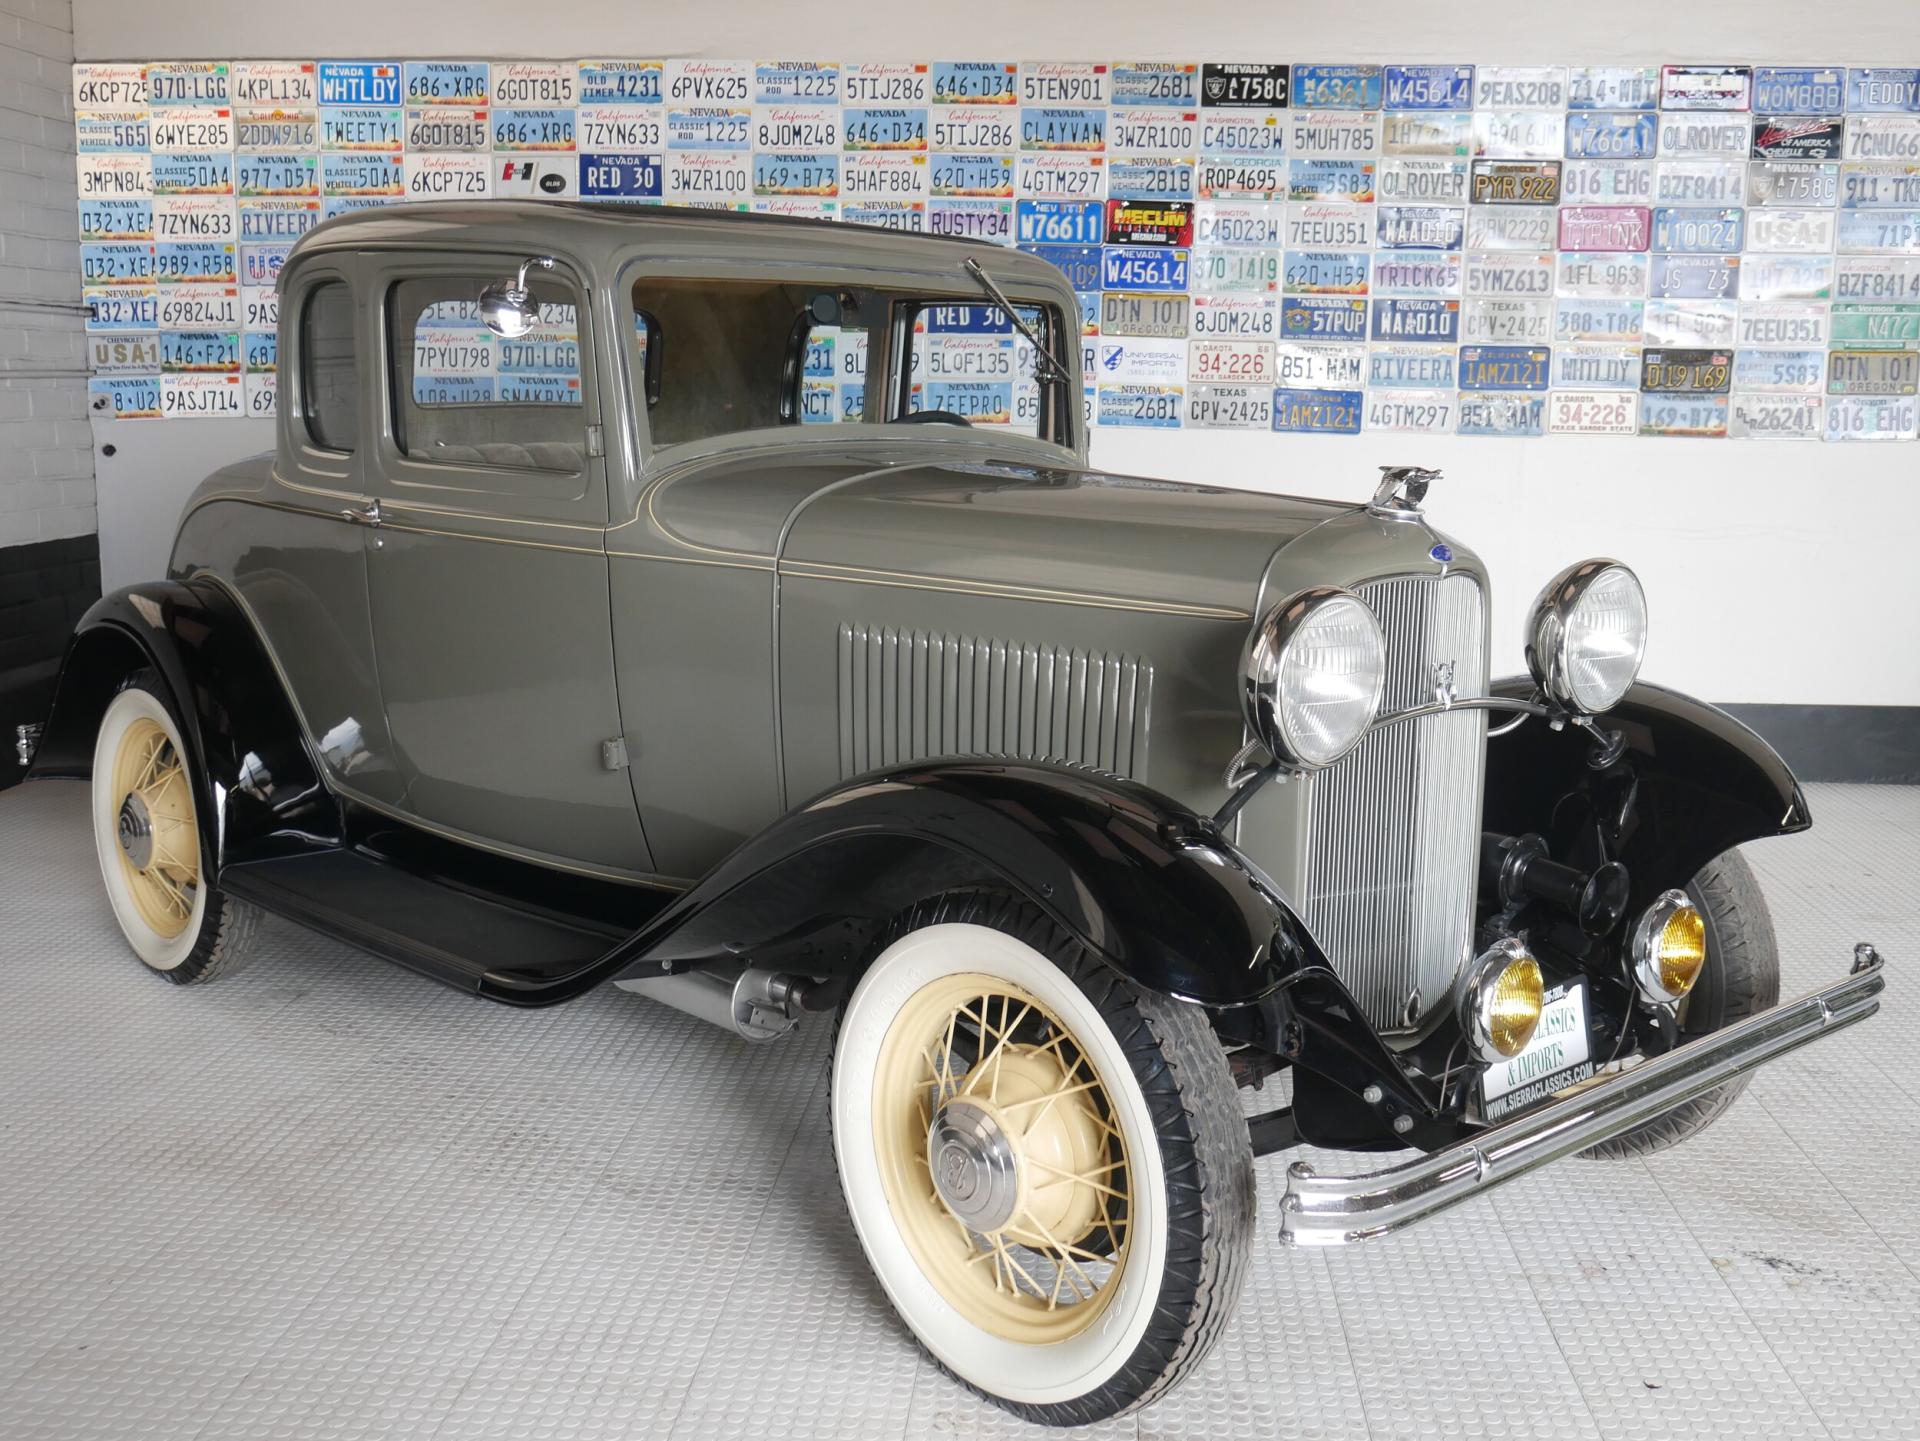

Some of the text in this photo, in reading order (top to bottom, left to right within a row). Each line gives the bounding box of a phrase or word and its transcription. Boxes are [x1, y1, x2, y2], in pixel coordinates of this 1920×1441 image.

[170, 65, 208, 73] NEVADA
[325, 68, 363, 76] NEVADA
[509, 66, 560, 76] California
[601, 63, 641, 71] NEVADA
[684, 64, 736, 75] California
[778, 63, 817, 71] NEVADA
[861, 65, 913, 75] California
[1039, 65, 1091, 75] California
[1136, 64, 1176, 73] NEVADA
[1225, 65, 1268, 74] NEVADA
[588, 76, 606, 85] OLD
[756, 77, 792, 85] CLASSIC
[1115, 76, 1148, 84] CLASSIC
[238, 79, 311, 99] 4KPL134
[323, 79, 397, 100] WHTLDY
[617, 76, 660, 97] 4231
[672, 77, 747, 99] 6PVX625
[794, 76, 835, 96] 1225
[847, 78, 923, 99] 5TIJ286
[1026, 79, 1102, 100] 5TEN901
[1115, 86, 1147, 95] VEHICLE
[1150, 76, 1192, 97] 2681
[1389, 80, 1468, 102] W45614
[583, 88, 613, 97] TIMER
[99, 113, 136, 121] NEVADA
[342, 110, 381, 118] NEVADA
[422, 112, 472, 121] California
[513, 110, 554, 118] NEVADA
[596, 111, 647, 121] California
[772, 111, 824, 121] California
[949, 112, 1000, 121] California
[1043, 110, 1084, 118] NEVADA
[1128, 112, 1179, 123] California
[1309, 114, 1361, 125] California
[669, 122, 703, 130] CLASSIC
[705, 122, 747, 141] 1225
[156, 125, 228, 144] 6WYE285
[325, 122, 399, 143] TWEETY1
[585, 124, 658, 144] 7ZYN633
[936, 125, 1011, 146] 5TIJ286
[1024, 122, 1101, 142] CLAYVAN
[1115, 127, 1191, 148] 3WZR100
[1204, 127, 1282, 148] C45023W
[1296, 129, 1373, 150] 5MUH785
[343, 156, 382, 164] NEVADA
[422, 159, 475, 168] California
[602, 157, 640, 165] NEVADA
[683, 155, 735, 166] California
[859, 156, 910, 166] California
[952, 156, 993, 164] NEVADA
[1037, 157, 1090, 168] California
[1234, 159, 1281, 167] GEORGIA
[1312, 161, 1353, 169] NEVADA
[588, 168, 654, 188] RED 30
[672, 170, 746, 191] 3WZR100
[846, 171, 921, 192] 5HAF884
[1112, 172, 1144, 180] CLASSIC
[1146, 171, 1190, 192] 2818
[412, 172, 485, 192] 6KCP725
[1023, 172, 1100, 192] 4GTM297
[1112, 183, 1144, 191] VEHICLE
[1566, 170, 1649, 195] 816 EHG
[1475, 177, 1556, 199] PYR 922
[864, 202, 904, 210] NEVADA
[1115, 209, 1185, 226] MECUM
[159, 215, 231, 234] 7ZYN633
[932, 212, 1008, 235] RUSTY34
[1022, 215, 1096, 240] W76611
[1291, 222, 1367, 244] 7EEU351
[1123, 251, 1161, 259] NEVADA
[1108, 262, 1184, 285] W45614
[1378, 266, 1457, 287] TRICK65
[172, 289, 223, 299] California
[1209, 300, 1264, 310] California
[1301, 300, 1348, 308] NEVADA
[1491, 303, 1525, 311] TEXAS
[164, 302, 235, 322] 69824J1
[1108, 300, 1182, 323] DTN 101
[1314, 311, 1365, 333] 57PUP
[1123, 325, 1167, 333] OREGON
[428, 334, 480, 344] California
[417, 349, 489, 368] 7PYU798
[1121, 385, 1161, 394] NEVADA
[1851, 383, 1895, 391] OREGON
[1214, 389, 1246, 397] TEXAS
[167, 392, 237, 410] 9ASJ714
[1135, 398, 1177, 419] 2681
[1370, 406, 1448, 426] 4GTM297
[1519, 1041, 1564, 1084] IMPORTS
[1486, 1062, 1594, 1120] WWW.SIERRACLASSICS.COM
